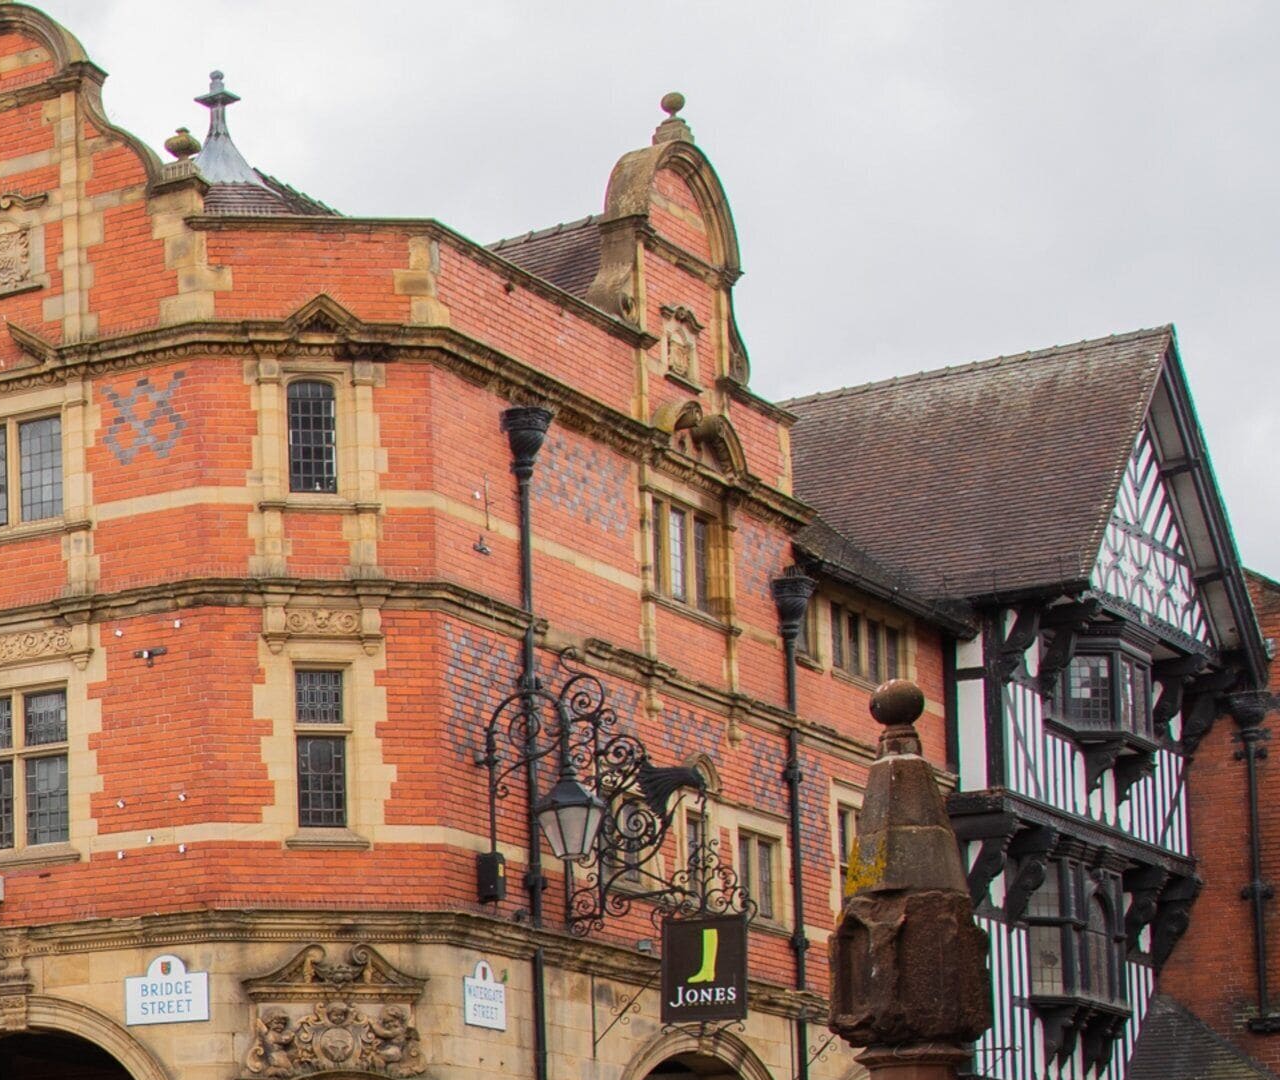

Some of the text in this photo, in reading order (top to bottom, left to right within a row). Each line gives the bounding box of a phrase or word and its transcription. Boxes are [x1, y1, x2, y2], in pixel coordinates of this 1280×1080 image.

[141, 980, 192, 997] BRIDGE
[669, 986, 737, 1008] JONES
[141, 999, 192, 1016] STREET
[473, 1003, 498, 1019] STREET
